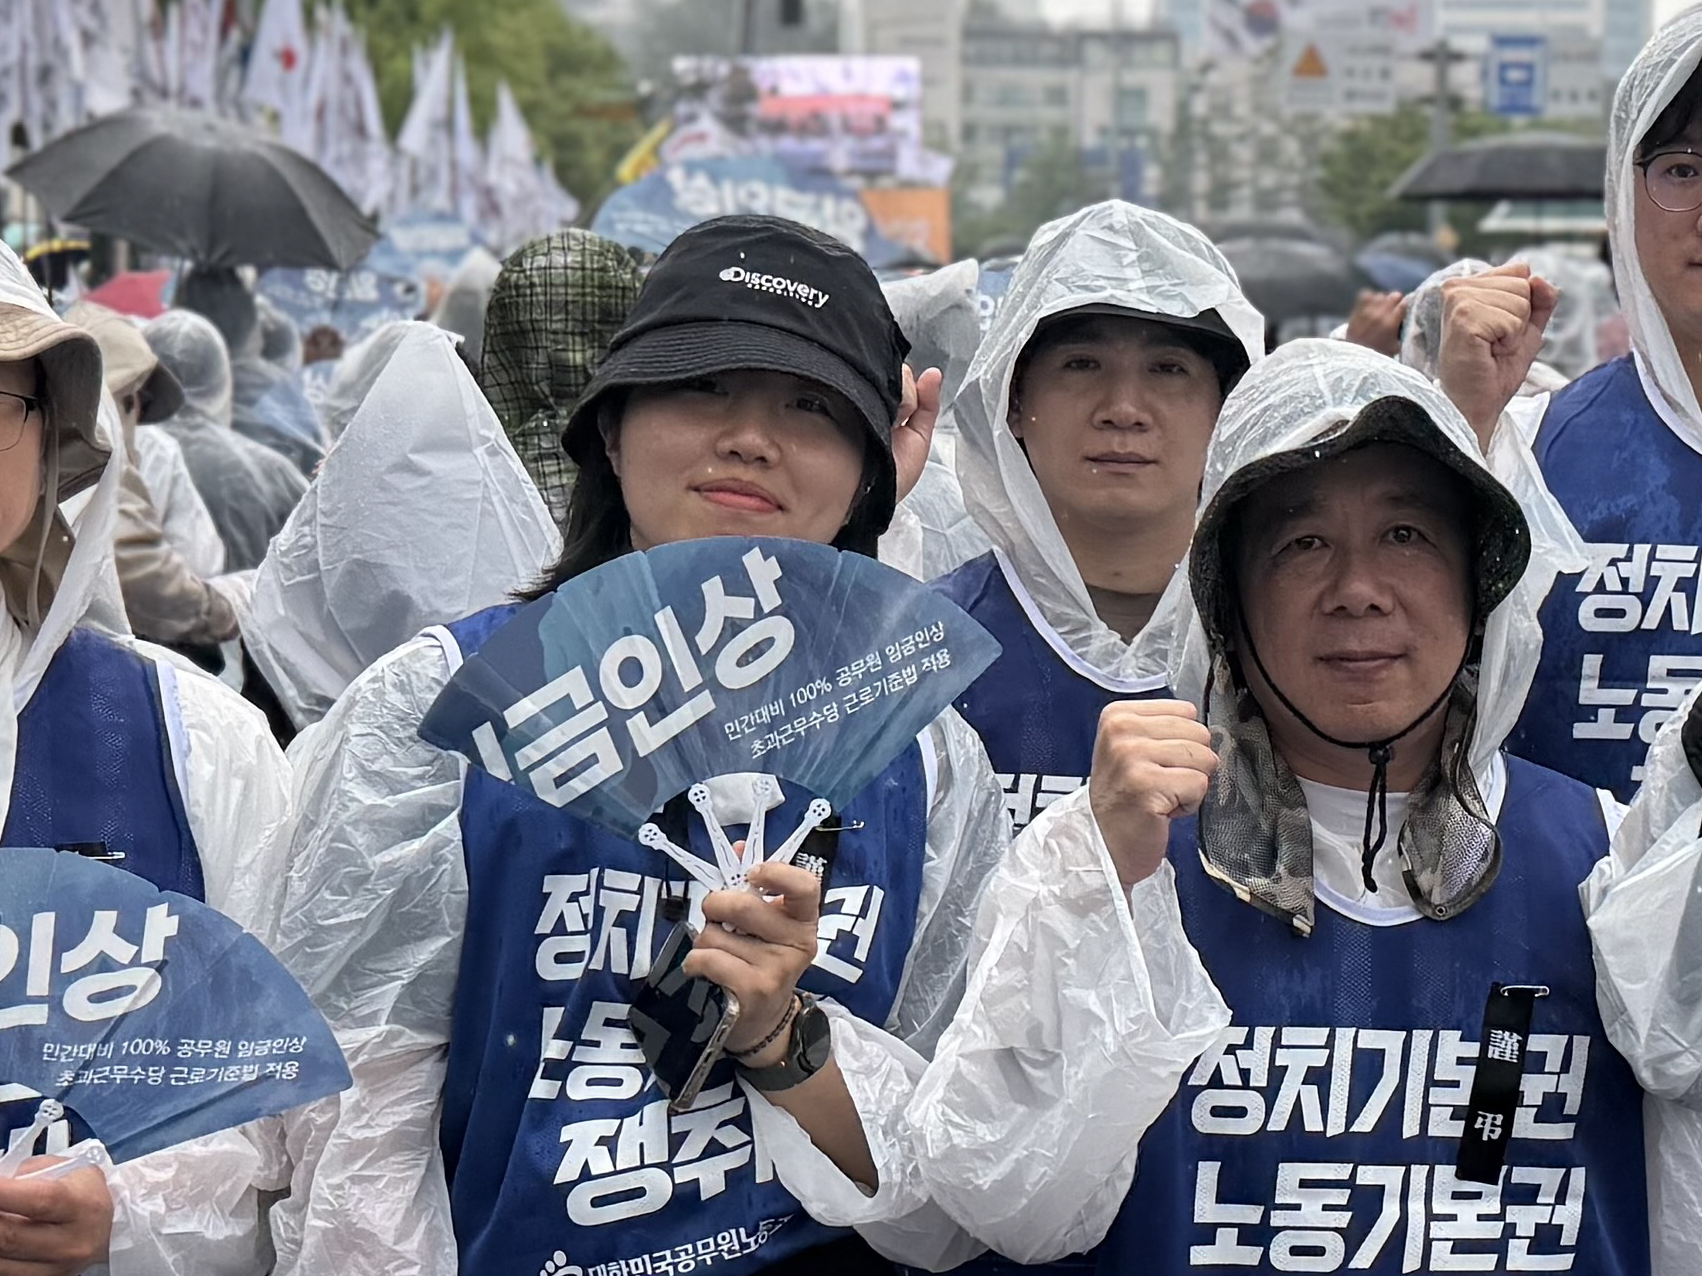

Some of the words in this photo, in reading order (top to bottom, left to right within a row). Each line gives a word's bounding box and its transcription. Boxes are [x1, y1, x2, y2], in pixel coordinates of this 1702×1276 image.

[724, 698, 786, 742] 민간대비
[789, 676, 833, 708] 100%
[835, 651, 883, 687] 공무원
[885, 620, 945, 664] 임금인상
[750, 701, 840, 760] 초과근무수당
[842, 666, 919, 715] 근로기준법
[920, 648, 952, 675] 적용
[42, 1041, 114, 1063] 민간대비
[120, 1038, 172, 1057] 100%
[176, 1038, 232, 1059] 공무원
[236, 1035, 308, 1059] 임금인상
[55, 1065, 165, 1087] 초과근무수당
[169, 1064, 259, 1086] 근로기준법
[263, 1060, 300, 1080] 적용
[1189, 1160, 1587, 1274] 노동기본권
